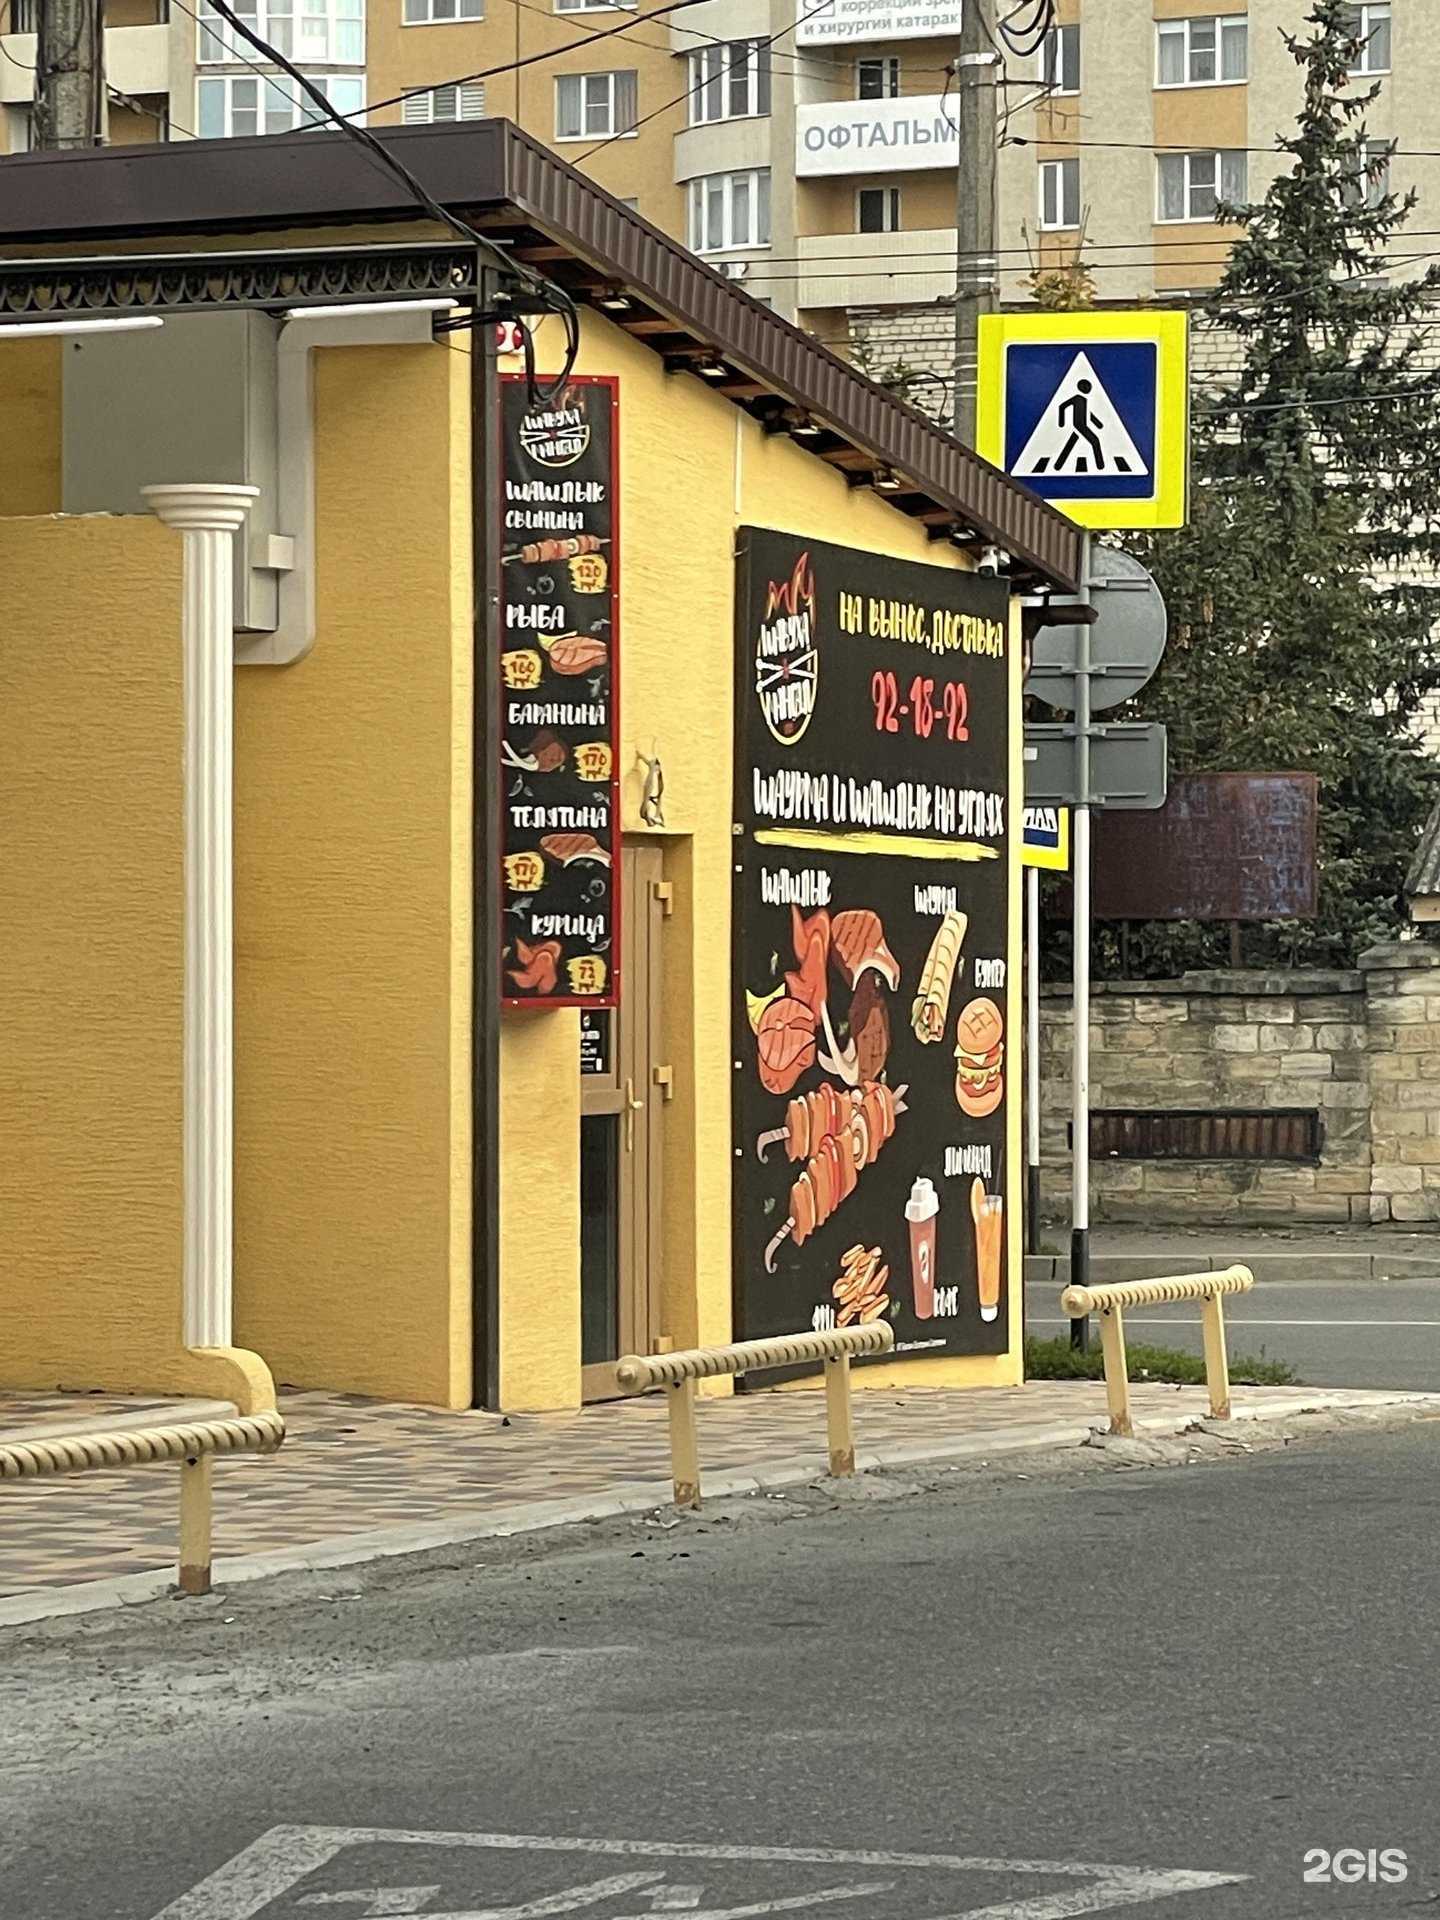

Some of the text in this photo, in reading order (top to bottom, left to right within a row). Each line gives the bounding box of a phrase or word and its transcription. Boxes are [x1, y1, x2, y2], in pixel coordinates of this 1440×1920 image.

[804, 25, 814, 35] и
[818, 19, 891, 36] хирургии
[804, 117, 957, 152] ОФТАЛЬМ
[505, 480, 606, 503] ШАШЛЫК
[505, 510, 584, 531] СВИНИНА
[577, 565, 602, 578] 120
[506, 604, 565, 629] РЫБА
[840, 591, 862, 635] НА
[508, 702, 606, 726] БАРАНИНА
[753, 768, 1004, 837] ШАУРМА И ШАШЛЫК НА УГЛЯХ
[510, 806, 607, 829] ТЕЛЯТИНА
[761, 867, 832, 907] ШАШЛЫК
[530, 914, 605, 943] КУРИЦА
